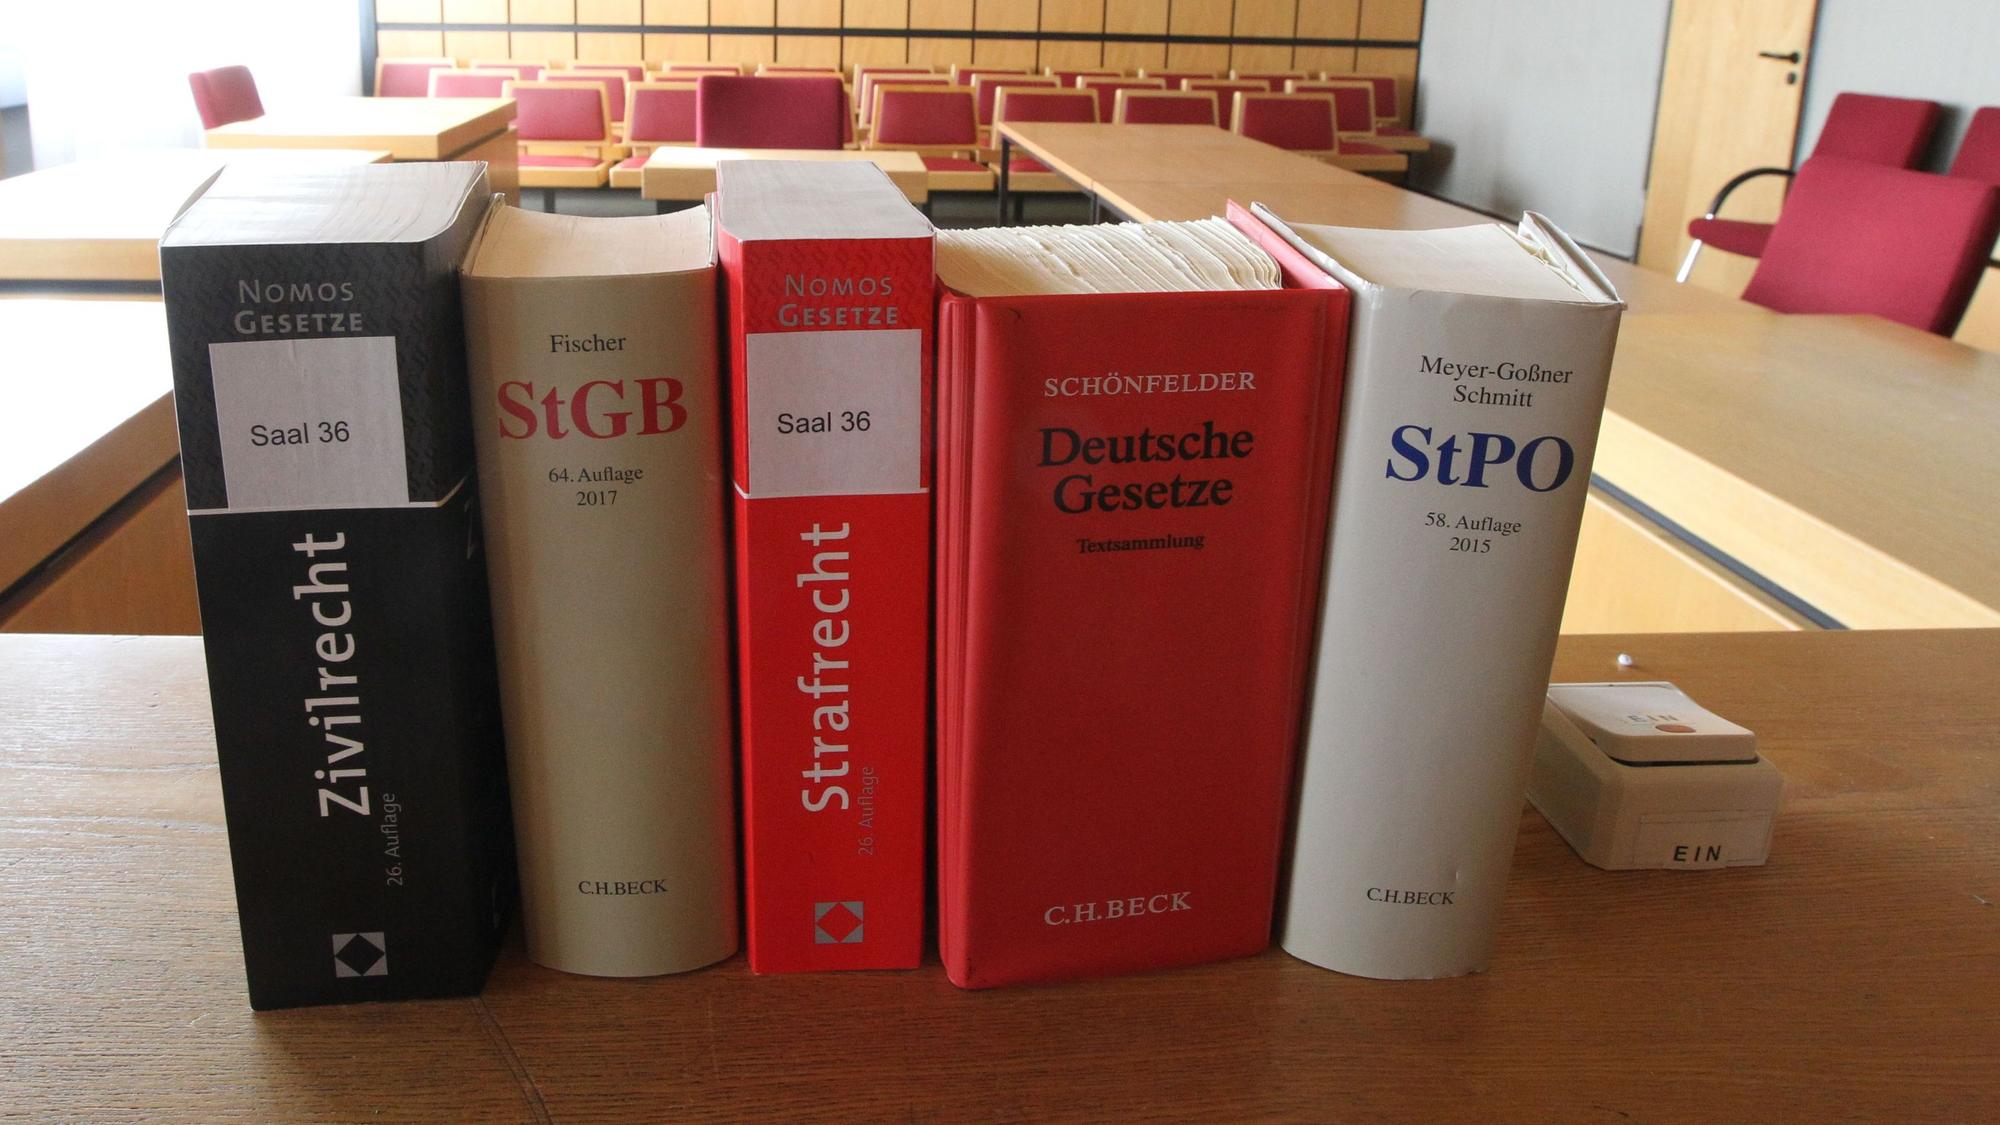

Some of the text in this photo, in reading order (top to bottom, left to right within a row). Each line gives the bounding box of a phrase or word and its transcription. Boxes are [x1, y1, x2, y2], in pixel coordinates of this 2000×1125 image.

[238, 279, 354, 304] NOMOS
[784, 274, 893, 298] NOMOS
[234, 310, 364, 335] GESETZE
[778, 303, 899, 328] GESETZE
[549, 333, 627, 354] Fischer
[1420, 355, 1573, 384] Meyer-Goßner
[1043, 371, 1257, 398] SCHÖNFELDER
[1453, 385, 1533, 407] Schmitt
[497, 377, 688, 441] StGB
[250, 420, 350, 447] Saal 36
[777, 410, 872, 434] Saal 36
[1037, 420, 1255, 467] Deutsche
[1386, 425, 1575, 492] StPO
[548, 466, 644, 485] 64. Auflage
[576, 490, 618, 506] 2017
[1053, 473, 1234, 515] Gesetze
[1425, 512, 1522, 536] 58. Auflage
[1077, 533, 1205, 554] Textsammlung
[1449, 537, 1491, 553] 2015
[292, 530, 371, 818] Zivilrecht
[796, 521, 851, 812] Strafrecht
[857, 766, 879, 828] Auflage
[380, 793, 402, 857] Auflage
[1673, 845, 1722, 862] EIN
[578, 879, 668, 897] C.H.BECK
[1366, 887, 1455, 905] C.H.BECK
[1043, 891, 1193, 926] C.H.BECK
